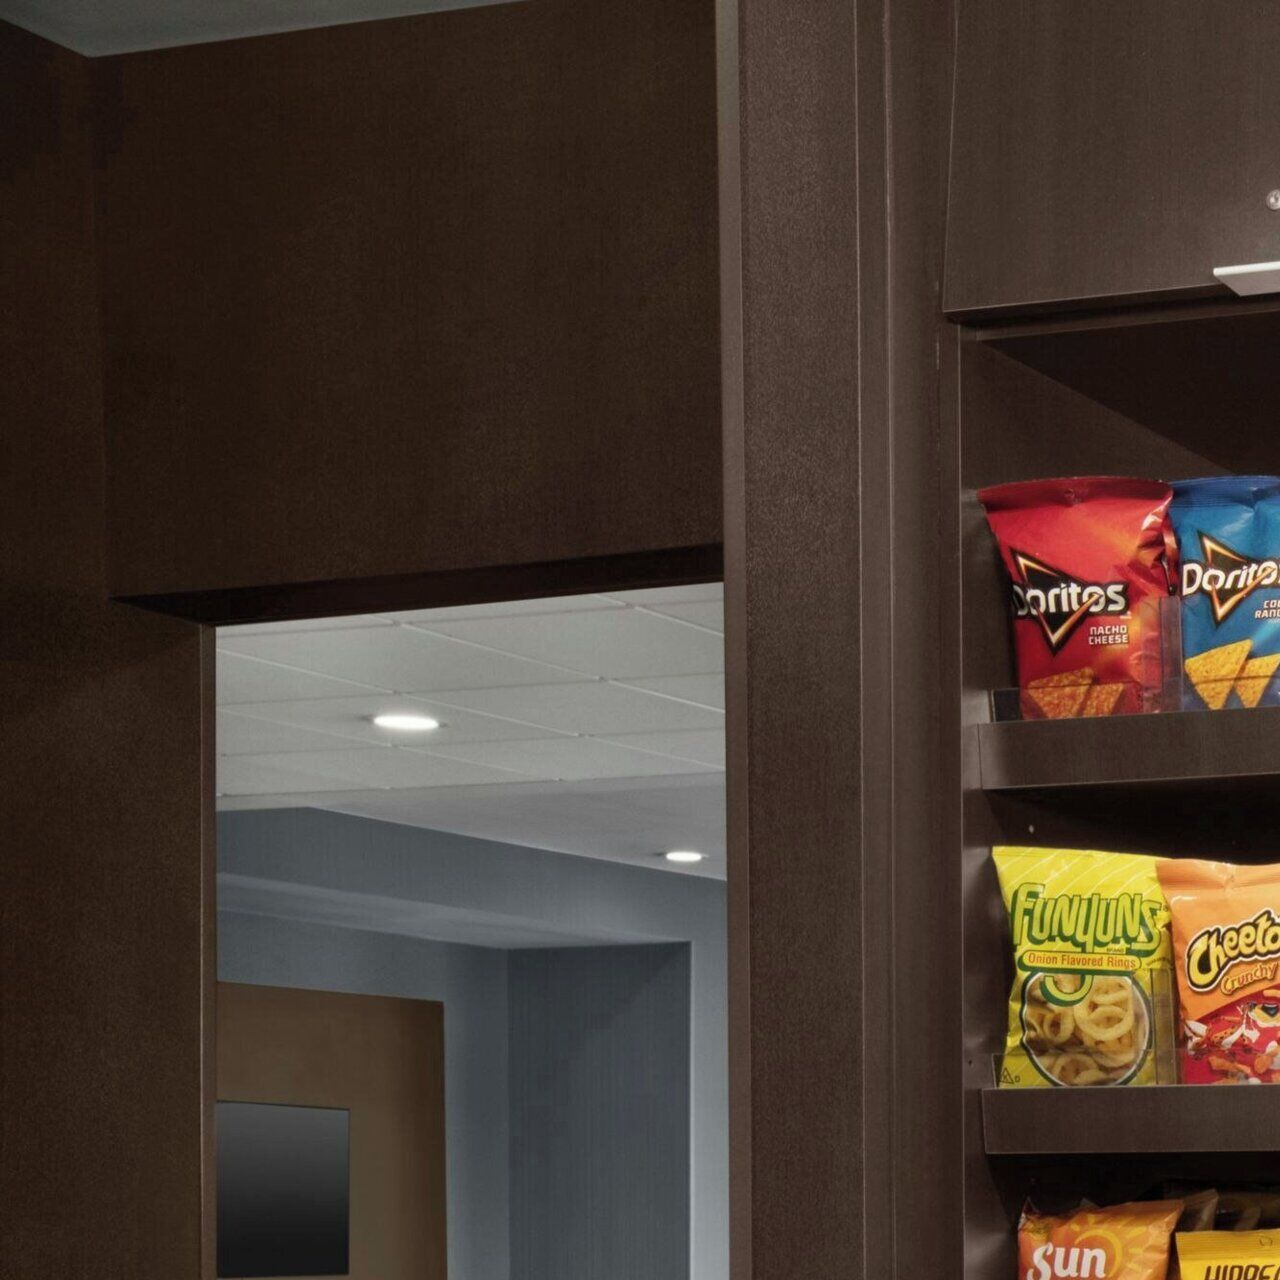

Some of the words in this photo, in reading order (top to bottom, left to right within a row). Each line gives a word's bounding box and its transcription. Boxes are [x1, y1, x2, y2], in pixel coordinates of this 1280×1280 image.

[1089, 625, 1128, 634] NACHO
[1088, 634, 1129, 645] CHEESE
[1028, 952, 1058, 966] Onion
[1061, 953, 1104, 967] Flavored
[1107, 955, 1137, 969] Rings
[1220, 962, 1279, 996] Crunchy
